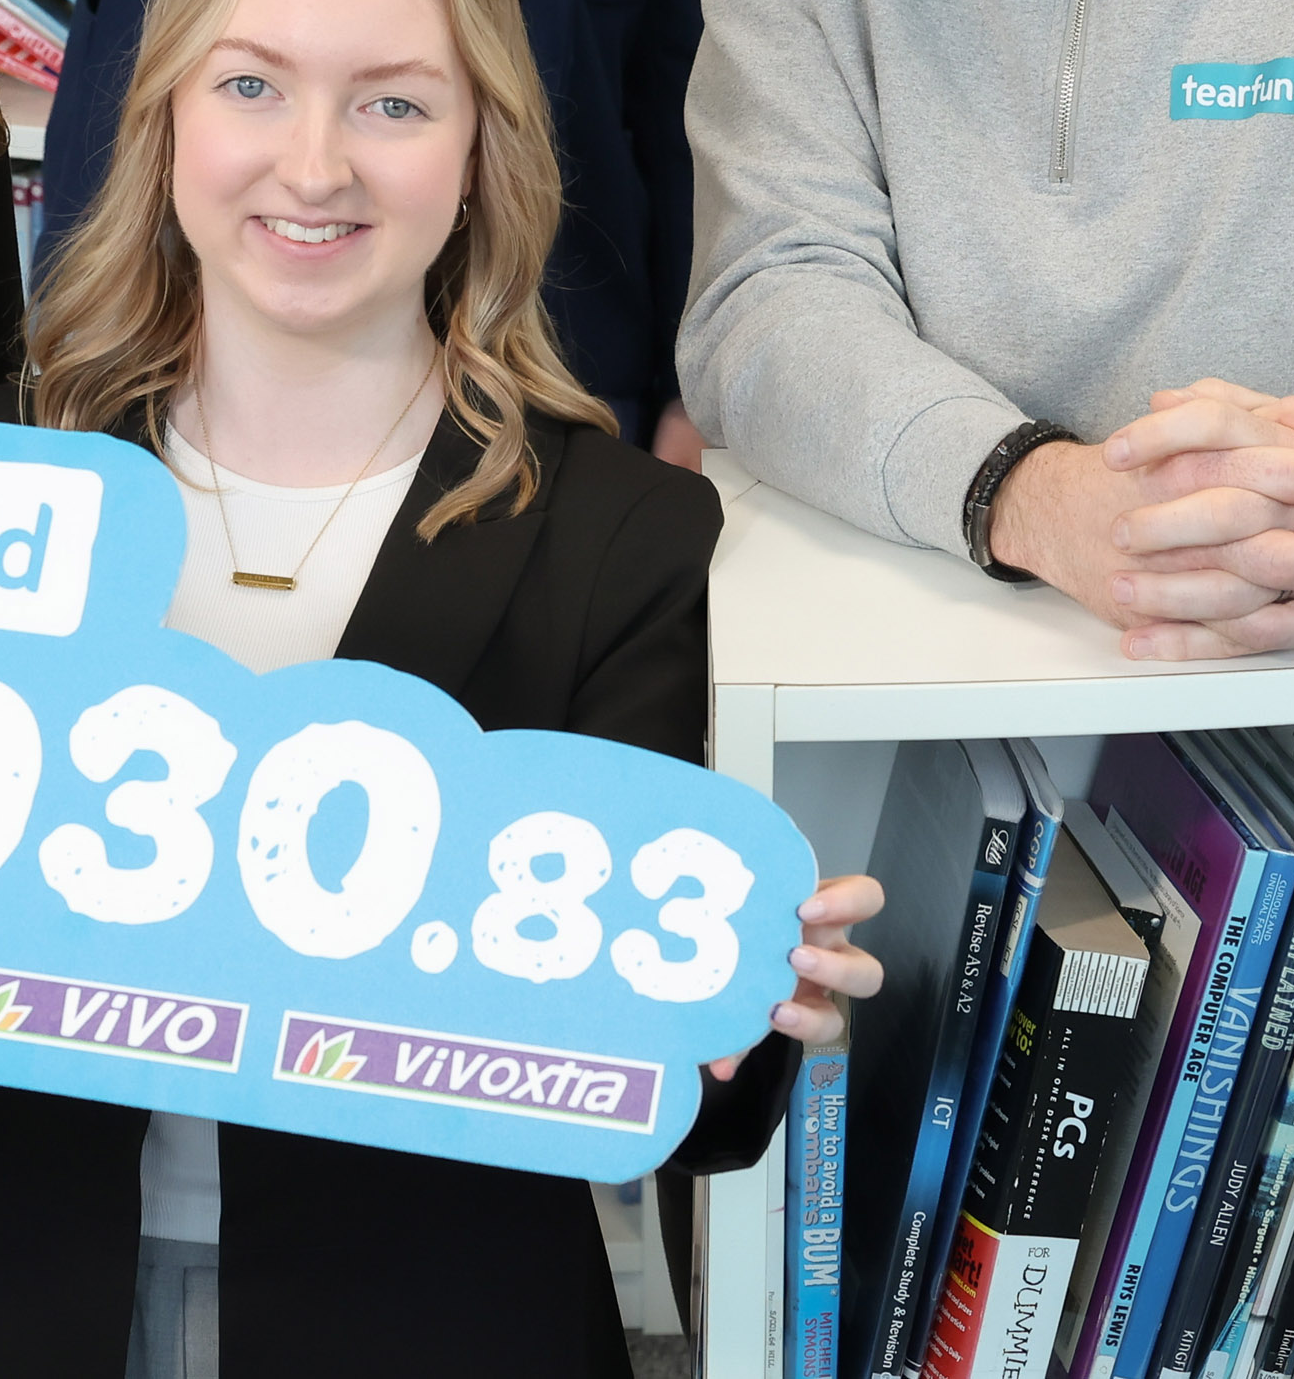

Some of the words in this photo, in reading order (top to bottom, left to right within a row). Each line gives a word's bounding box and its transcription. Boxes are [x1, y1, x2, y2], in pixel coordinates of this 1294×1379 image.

[1027, 820, 1044, 870] CGP
[1258, 872, 1279, 918] UNUSUAL
[1269, 879, 1288, 921] CURIOUS
[968, 903, 993, 954] Revise
[1223, 915, 1247, 947] THE
[1194, 952, 1235, 1045] COMPUTER
[1182, 1049, 1207, 1084] AGE
[822, 1093, 846, 1132] How
[932, 1096, 954, 1130] ICT
[1164, 986, 1263, 1213] VANISHINGS
[1053, 1091, 1094, 1160] PCs
[819, 1161, 844, 1209] avoid
[1023, 1147, 1046, 1220] REFERENCE
[1226, 1160, 1248, 1199] JUDY
[1268, 1144, 1294, 1199] Walmsley
[903, 1210, 926, 1268] Complete
[1209, 1200, 1235, 1246] ALLEN
[1252, 1209, 1275, 1255] Sargent
[1027, 1246, 1051, 1259] FOR
[893, 1271, 914, 1304] Study
[1122, 1263, 1142, 1302] RHYS
[803, 1317, 818, 1378] SYMONS
[882, 1320, 904, 1368] Revision
[1105, 1304, 1129, 1348] LEWIS
